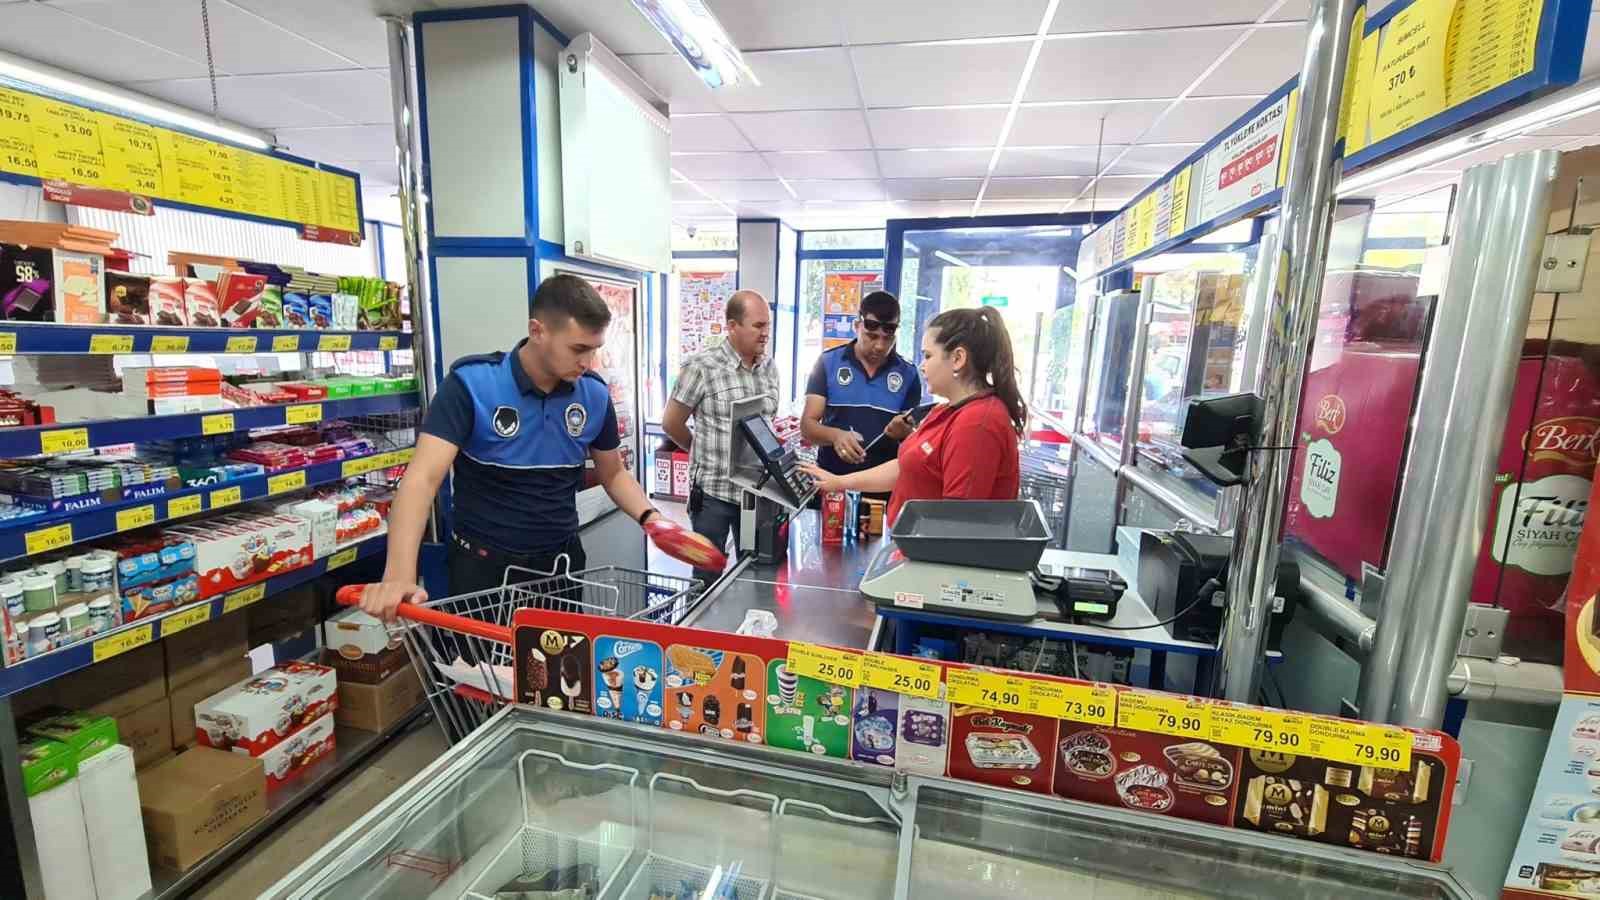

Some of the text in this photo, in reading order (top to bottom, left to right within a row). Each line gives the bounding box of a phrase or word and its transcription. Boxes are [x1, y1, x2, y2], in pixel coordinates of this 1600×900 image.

[1388, 70, 1406, 91] 370
[1310, 452, 1336, 485] Filiz
[134, 485, 166, 499] FALIM
[64, 497, 102, 512] FALIM
[818, 662, 854, 681] 25,00
[894, 673, 931, 692] 25,00
[981, 688, 1020, 706] 74,90
[1065, 700, 1106, 718] 73,90
[1158, 713, 1201, 731] 79,90
[1253, 728, 1299, 747] 79,90
[1354, 743, 1401, 762] 79,90
